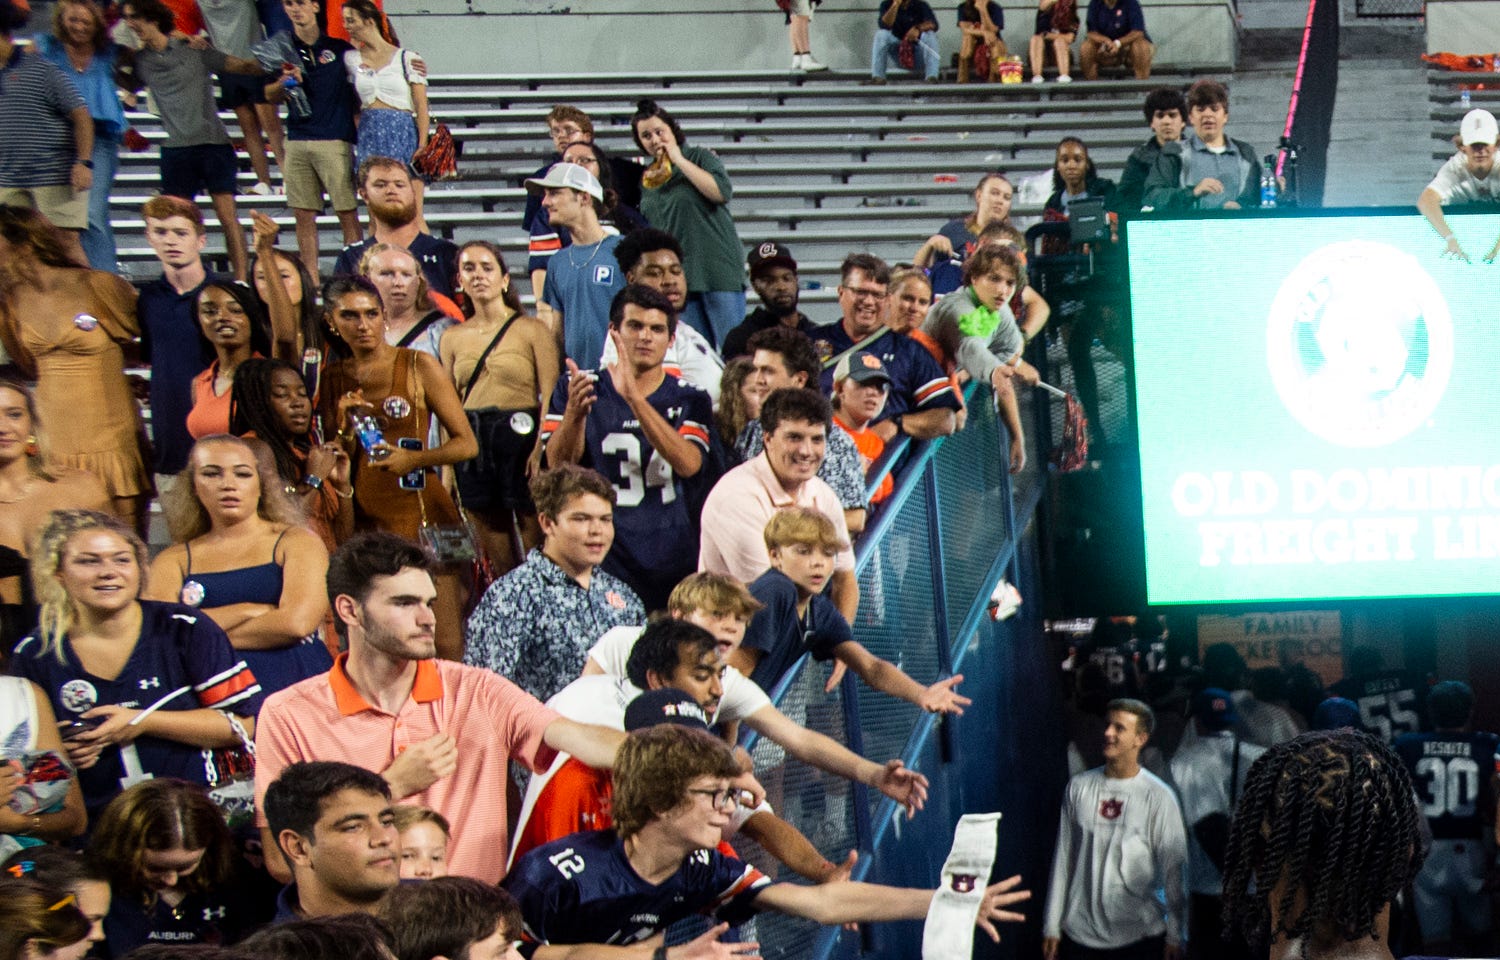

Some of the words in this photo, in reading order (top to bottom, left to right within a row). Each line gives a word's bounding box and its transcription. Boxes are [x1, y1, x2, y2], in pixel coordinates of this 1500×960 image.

[596, 266, 611, 281] P
[602, 433, 677, 507] 34
[1171, 471, 1279, 517] OLD
[1197, 516, 1418, 567] FREIGHT
[1245, 614, 1319, 636] FAMILY
[1416, 757, 1479, 818] 30
[548, 848, 586, 881] 12
